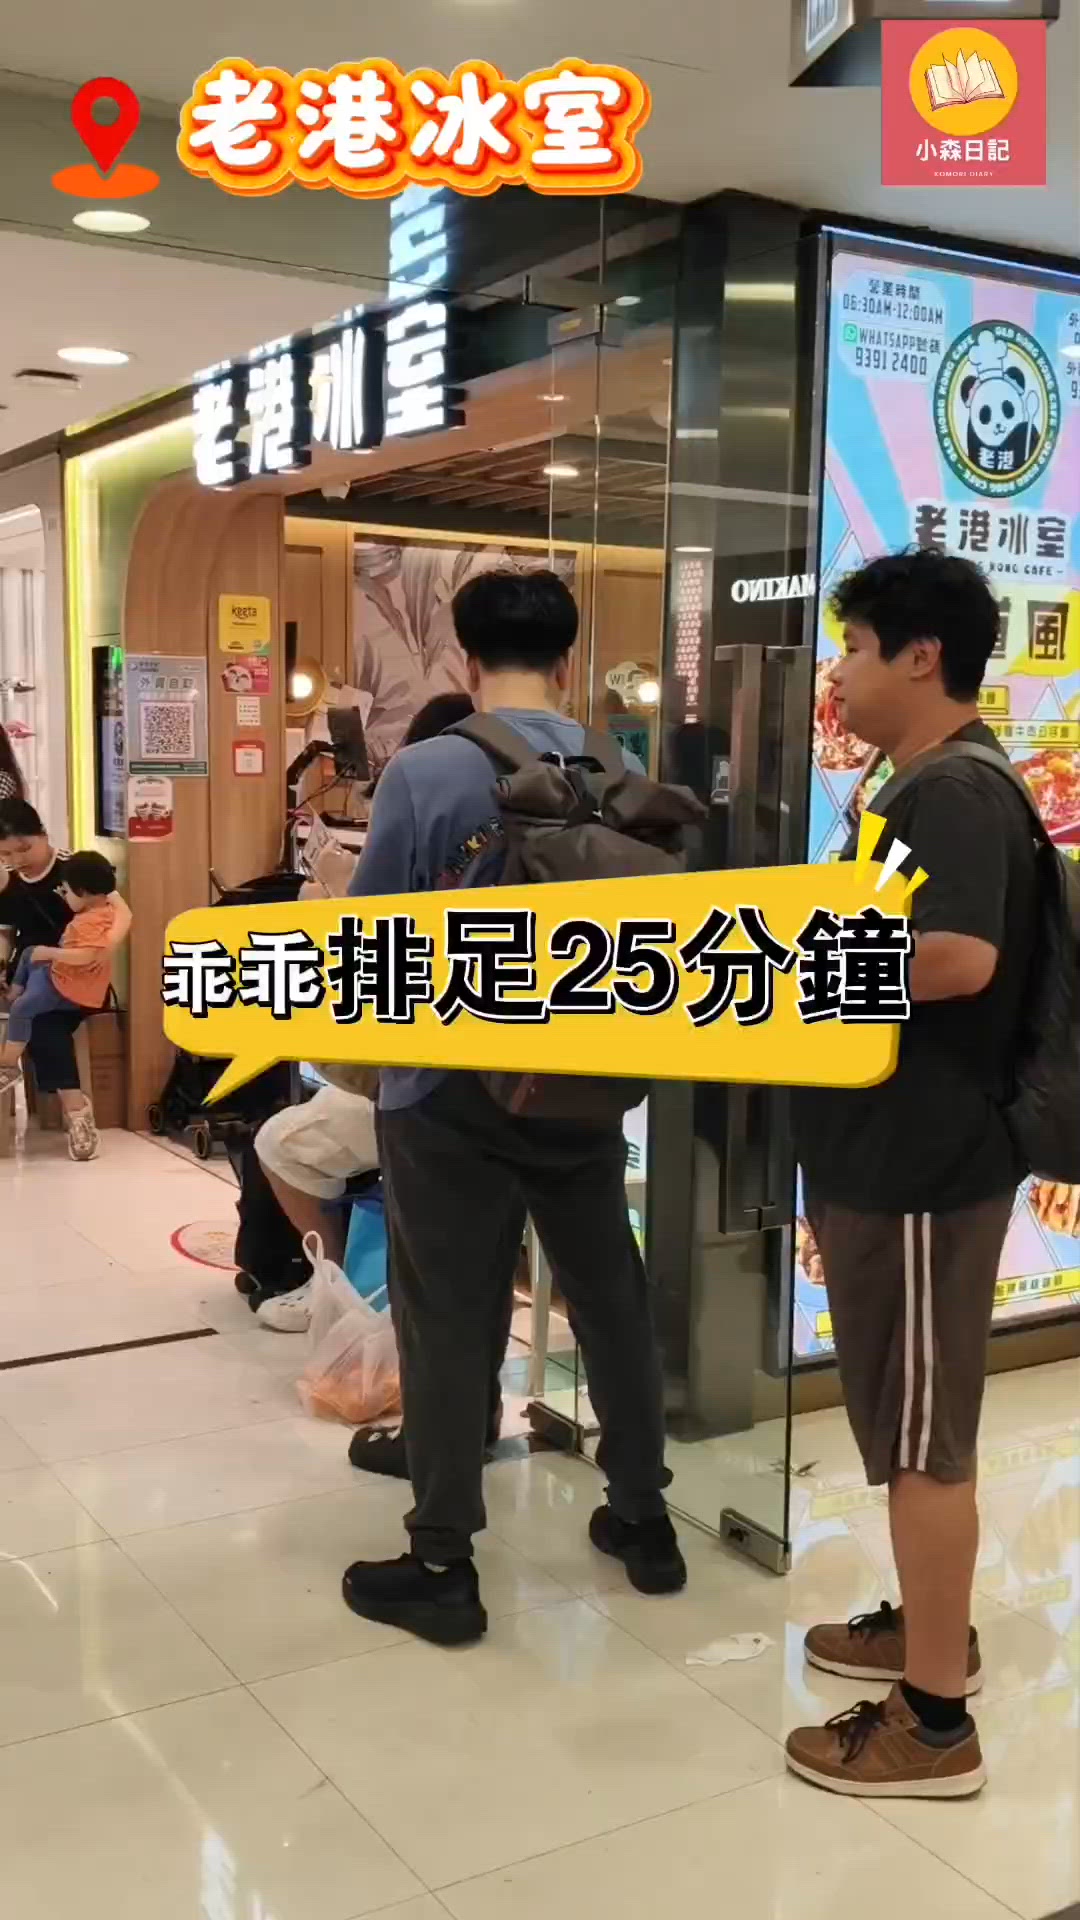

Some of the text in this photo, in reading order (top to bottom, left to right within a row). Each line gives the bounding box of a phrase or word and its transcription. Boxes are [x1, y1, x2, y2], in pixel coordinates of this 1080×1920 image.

[855, 347, 928, 376] 9391 2400
[191, 300, 449, 487] 老港冰室
[914, 503, 1067, 559] 老港冰室
